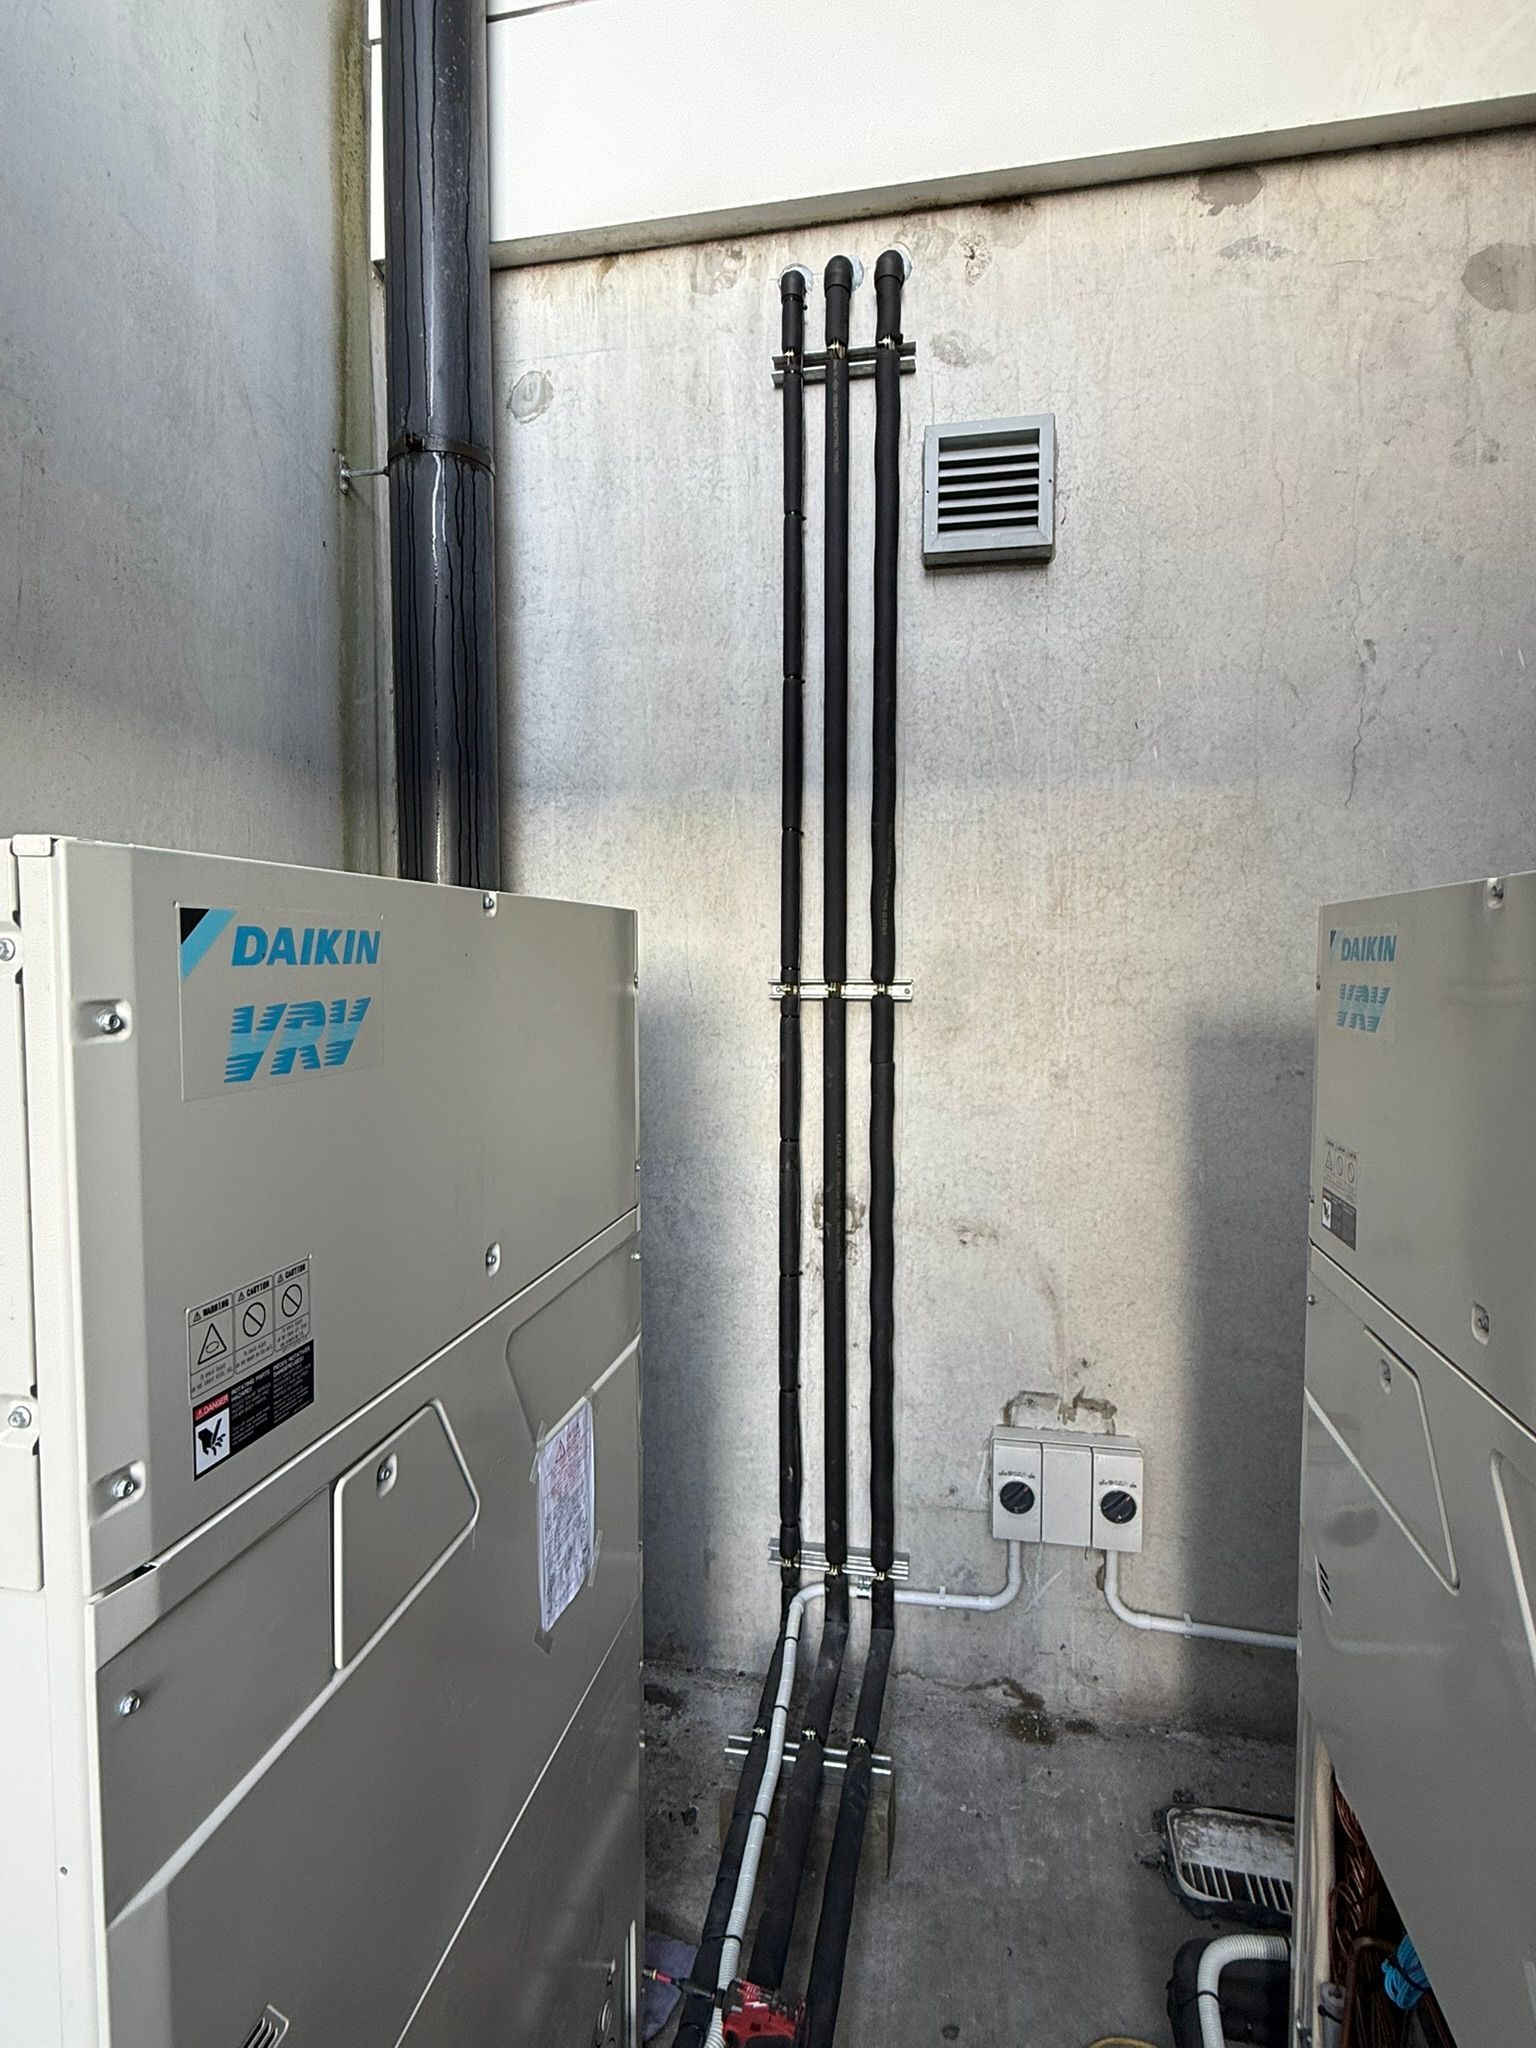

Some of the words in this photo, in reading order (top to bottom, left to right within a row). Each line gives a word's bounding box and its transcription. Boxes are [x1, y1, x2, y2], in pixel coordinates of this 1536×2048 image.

[231, 925, 381, 967] DAIKIN
[1340, 934, 1397, 962] DAIKIN
[223, 996, 372, 1083] VRV
[285, 1263, 306, 1279] CAUTION
[246, 1280, 270, 1297] CAUTION
[202, 1299, 229, 1316] WARNING
[203, 1393, 229, 1416] DANGER
